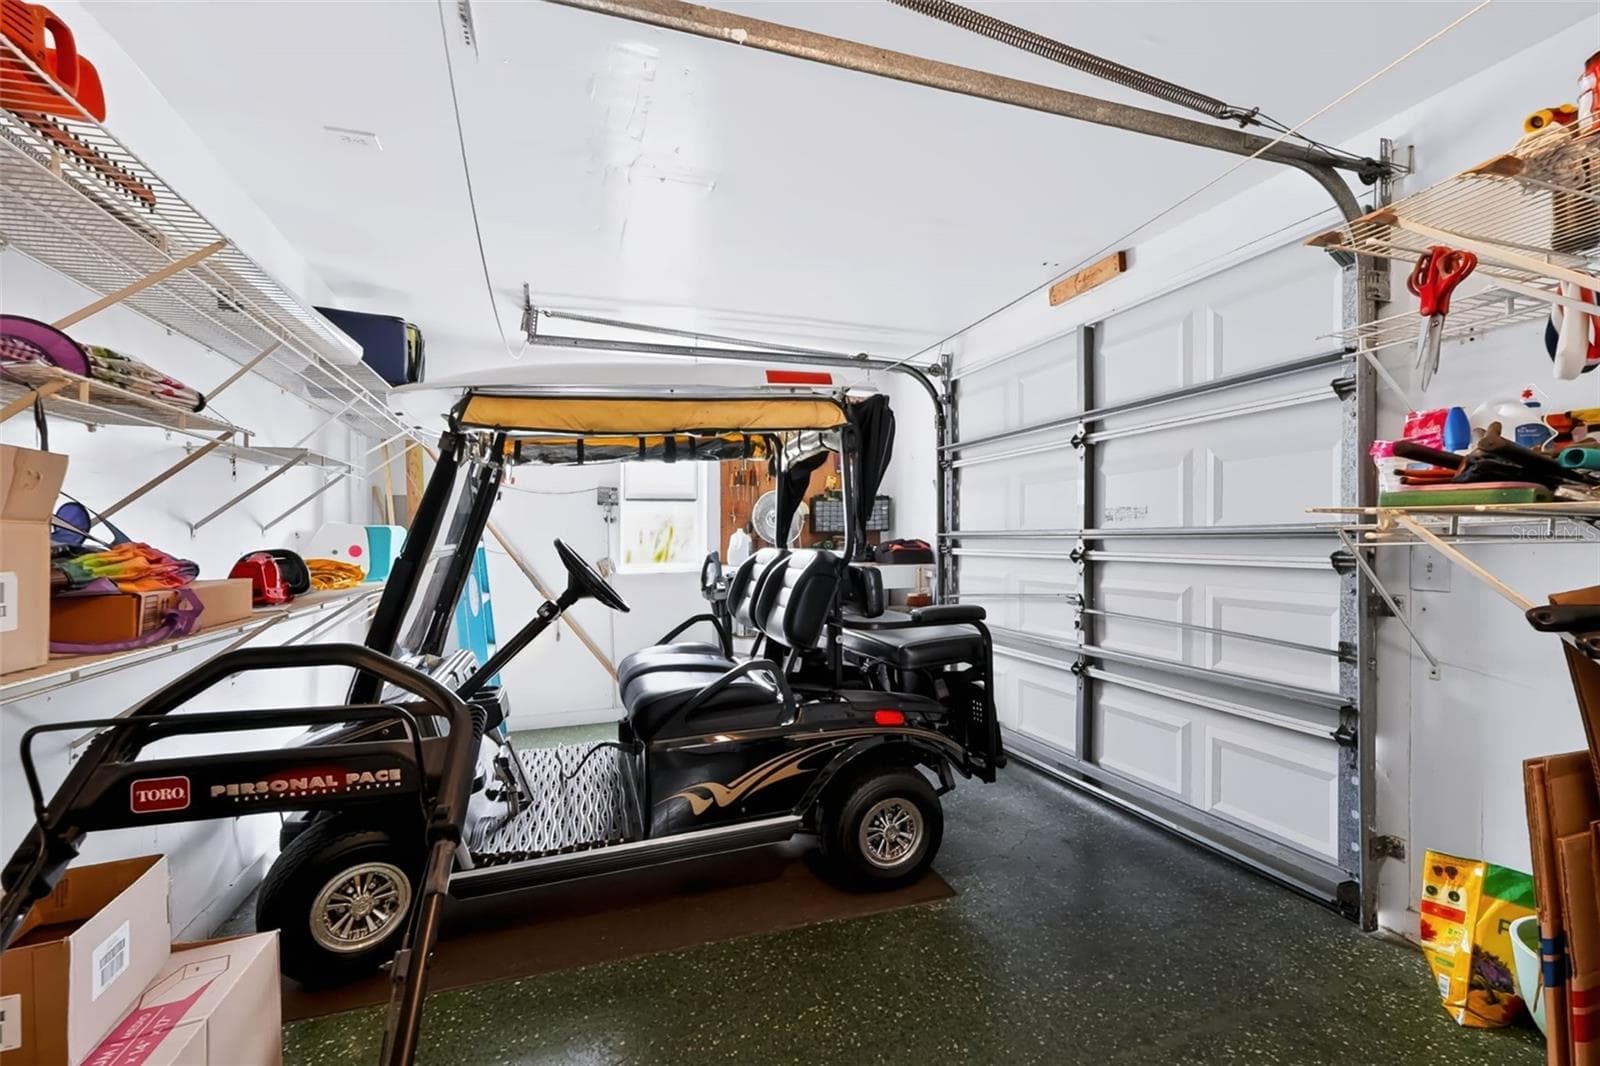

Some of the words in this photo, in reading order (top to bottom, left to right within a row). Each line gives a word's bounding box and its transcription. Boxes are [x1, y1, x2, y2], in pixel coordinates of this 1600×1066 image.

[210, 777, 339, 797] PERSONAL
[345, 768, 401, 785] PACE
[136, 786, 186, 802] TORO
